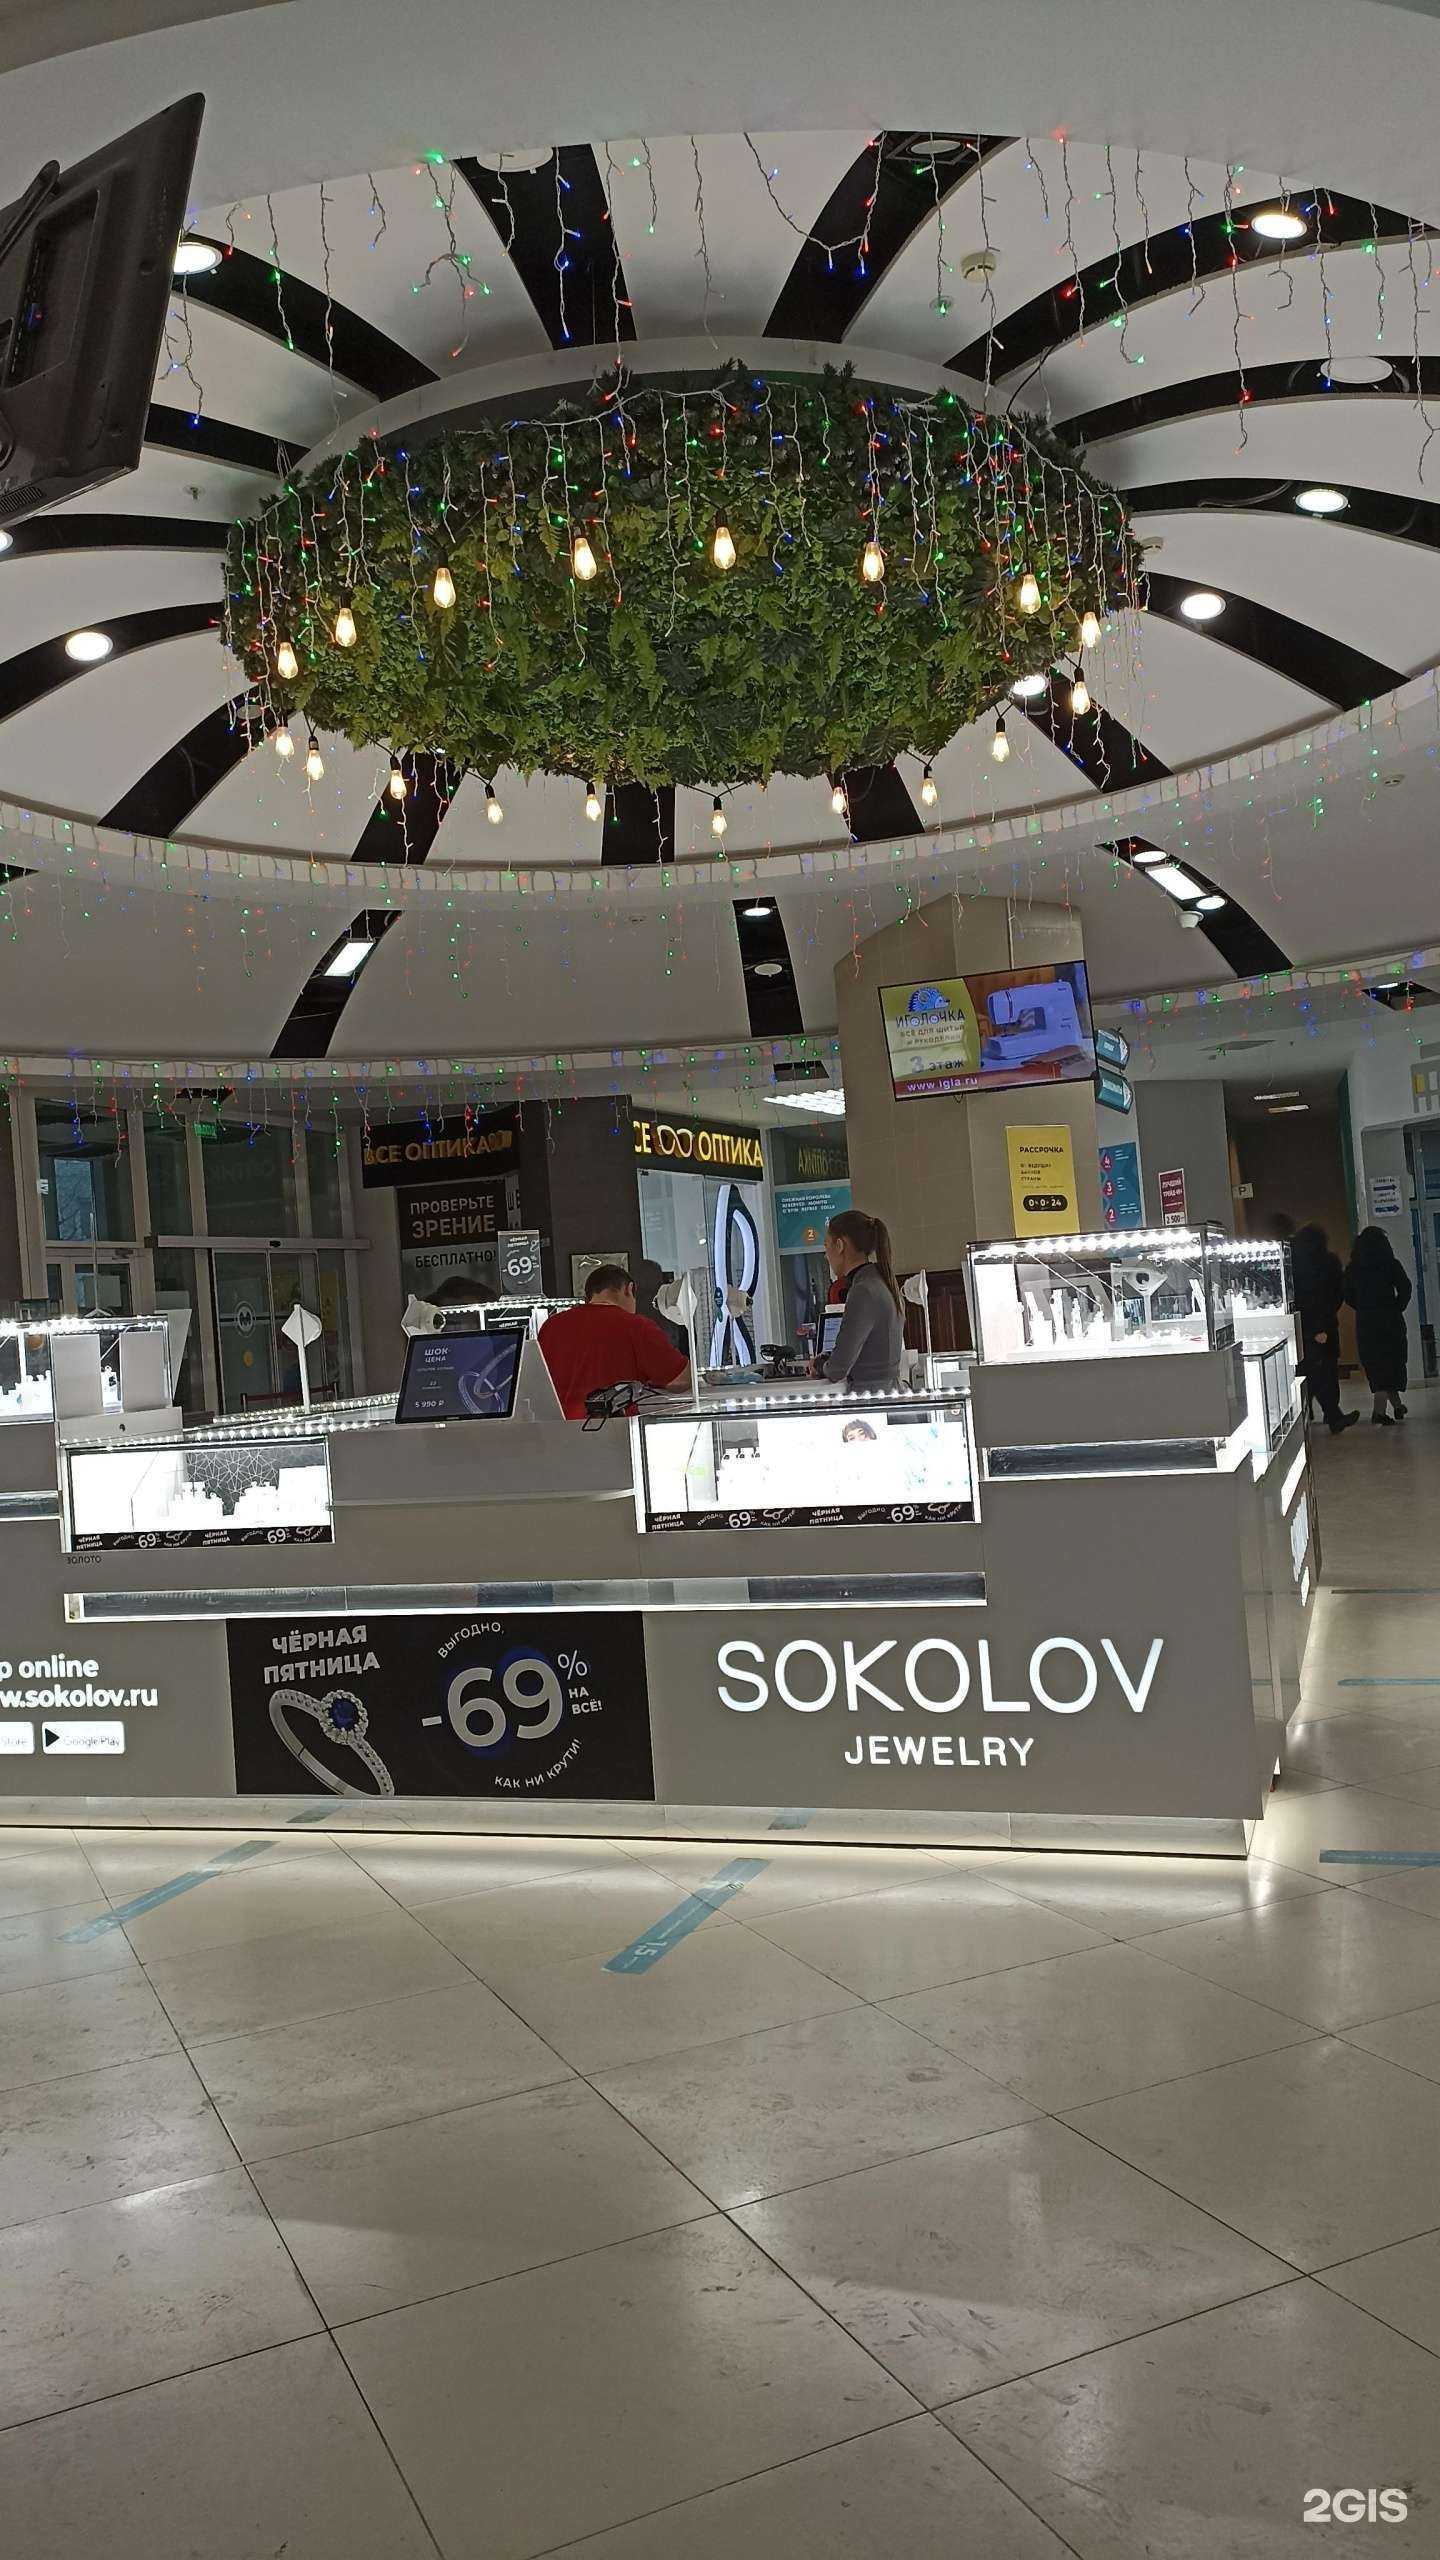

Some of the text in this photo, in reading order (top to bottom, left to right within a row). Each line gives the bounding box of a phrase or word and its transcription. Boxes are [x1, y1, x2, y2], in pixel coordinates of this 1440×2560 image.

[895, 1009, 966, 1028] ИГОЛОЧКА
[404, 1134, 492, 1161] ОПТИКА
[698, 1131, 764, 1167] ОПТИКА
[410, 1195, 495, 1215] ПРОВЕРЬТЕ
[412, 1214, 496, 1239] ЗРЕНИЕ
[415, 1250, 497, 1268] БЕСПЛАТНО!
[654, 1513, 681, 1522] ЧЁРНАЯ
[809, 1515, 845, 1525] ПЯТНИЦА
[811, 1507, 841, 1516] ЧЁРНАЯ
[651, 1520, 685, 1530] ПЯТНИЦА
[272, 1625, 368, 1654] ЧЁРНАЯ
[438, 1621, 505, 1658] ВЫГОДНО,
[18, 1653, 100, 1679] online
[264, 1652, 380, 1684] ПЯТНИЦА
[717, 1637, 1164, 1714] SOKOLOV
[568, 1687, 589, 1699] НА
[572, 1699, 603, 1715] ВСЁ!
[844, 1735, 1035, 1766] JEWELRY
[494, 1738, 582, 1789] КАК НИ КРУТИ!
